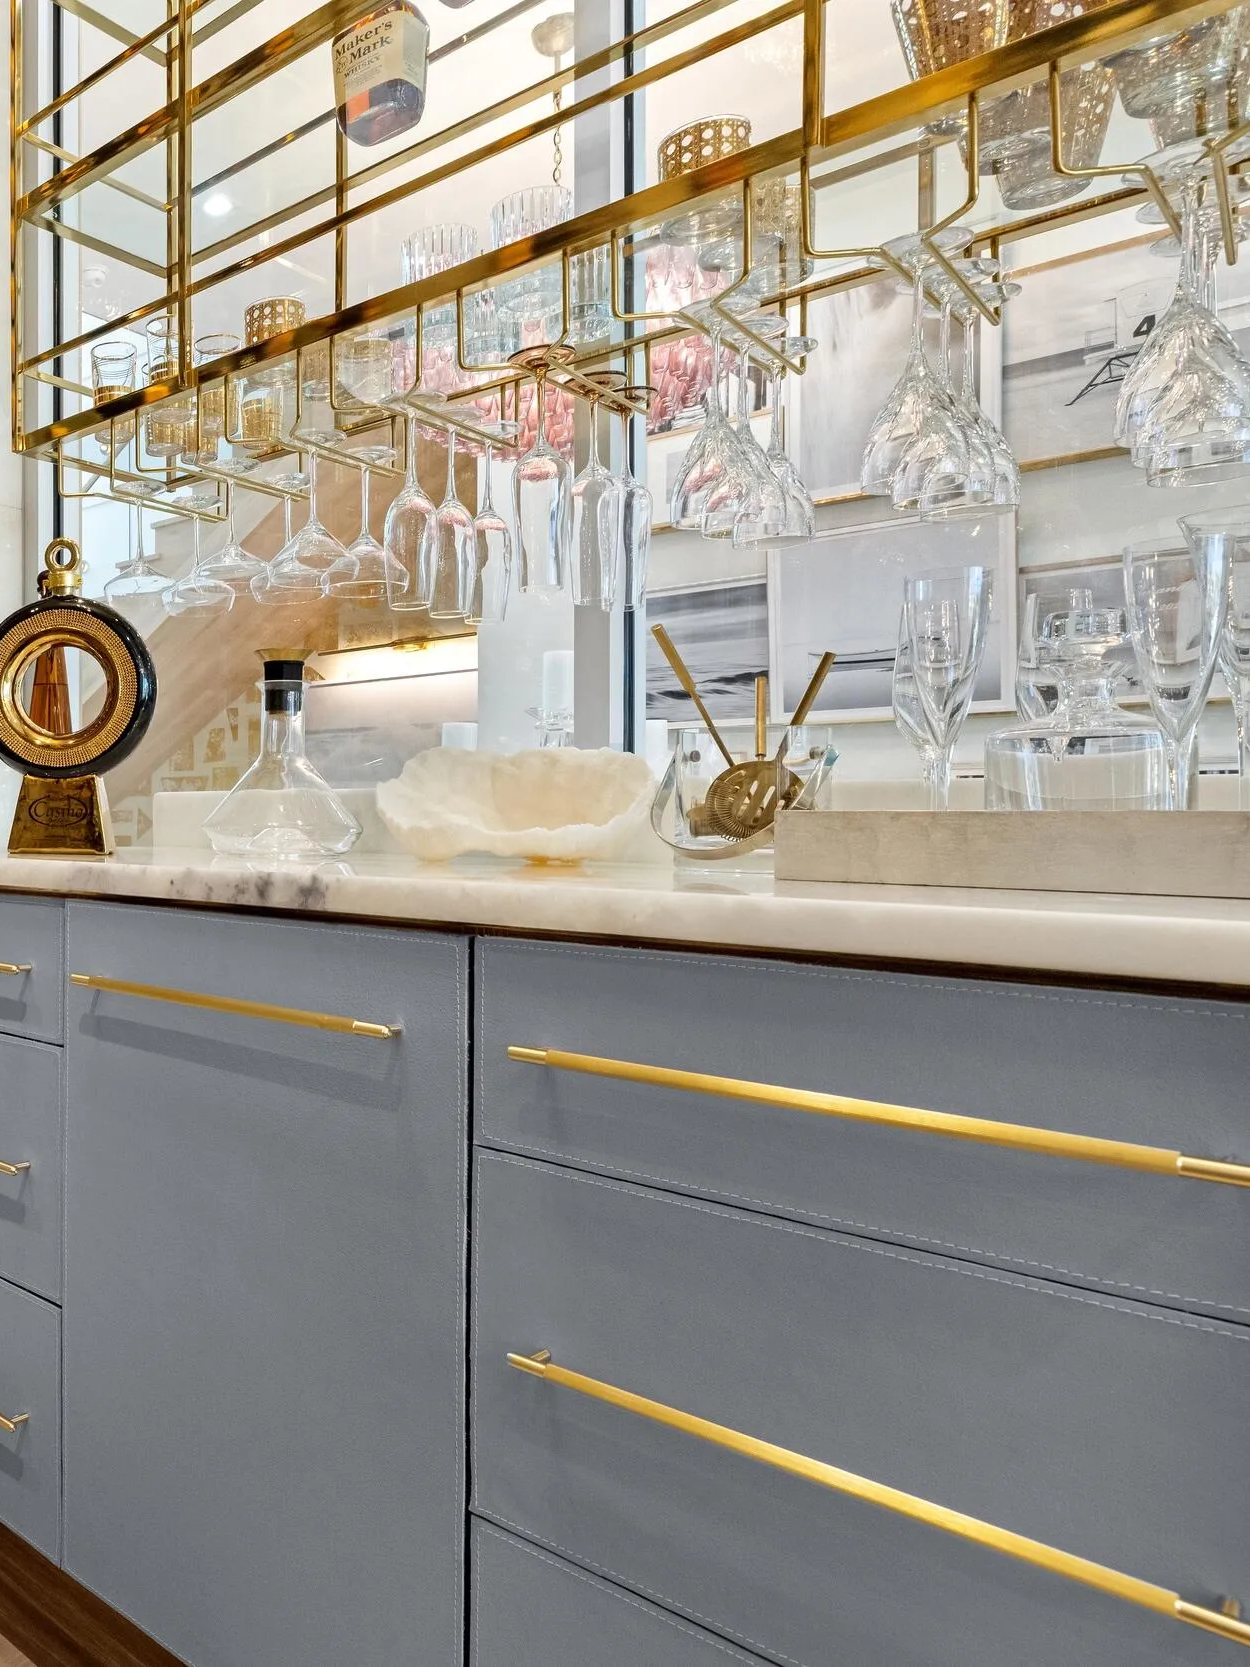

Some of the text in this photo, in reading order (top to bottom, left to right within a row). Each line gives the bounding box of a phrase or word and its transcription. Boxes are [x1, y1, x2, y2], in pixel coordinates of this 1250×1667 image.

[335, 20, 392, 60] Maker's
[349, 35, 391, 64] Mark
[344, 54, 382, 78] WHISKY
